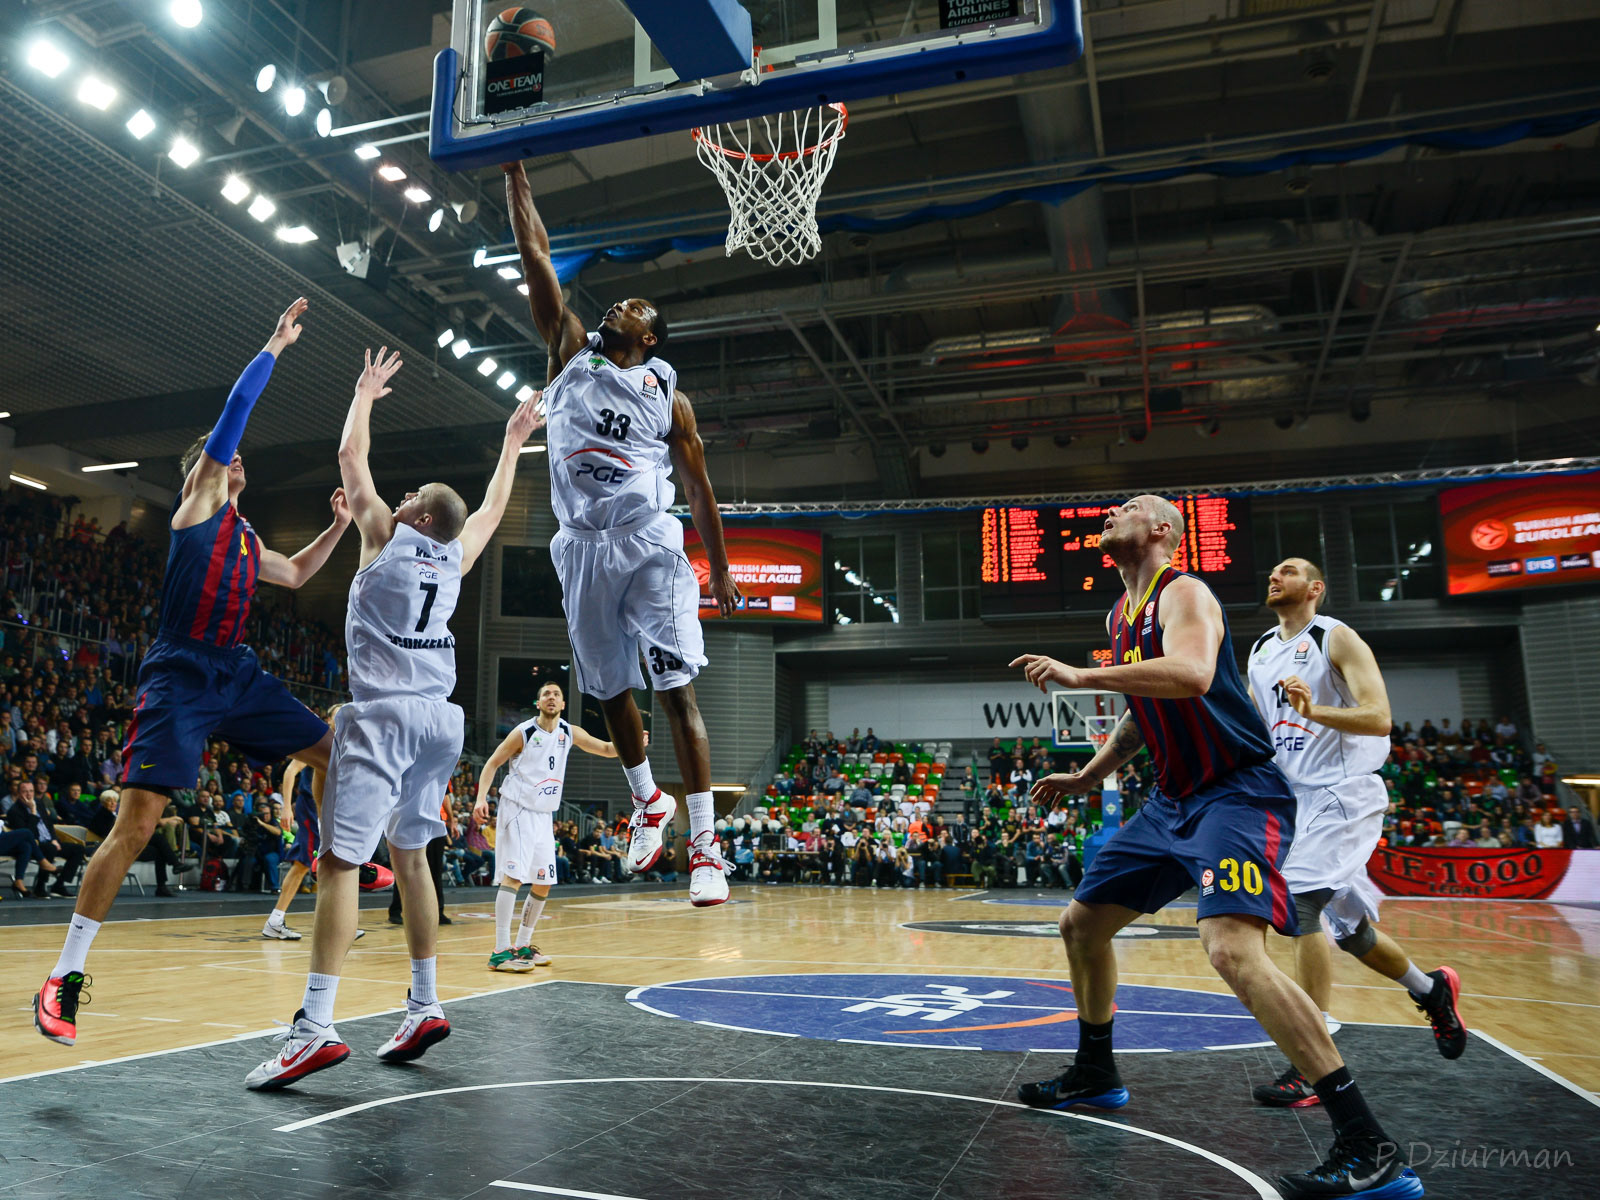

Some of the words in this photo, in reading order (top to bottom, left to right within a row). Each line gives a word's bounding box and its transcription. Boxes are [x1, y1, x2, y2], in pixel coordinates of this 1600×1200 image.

[947, 1, 1010, 19] AIRLINES
[948, 10, 1011, 27] EUROLEAGUE
[596, 408, 631, 441] 33
[576, 462, 629, 484] PGE
[1514, 524, 1600, 543] EUROLEA
[414, 581, 438, 633] 7
[1275, 736, 1305, 751] PGE
[548, 755, 555, 771] 8
[548, 864, 555, 879] 8
[1378, 850, 1543, 884] TF-1000
[1219, 857, 1264, 896] 30
[1429, 881, 1496, 896] LEGACY
